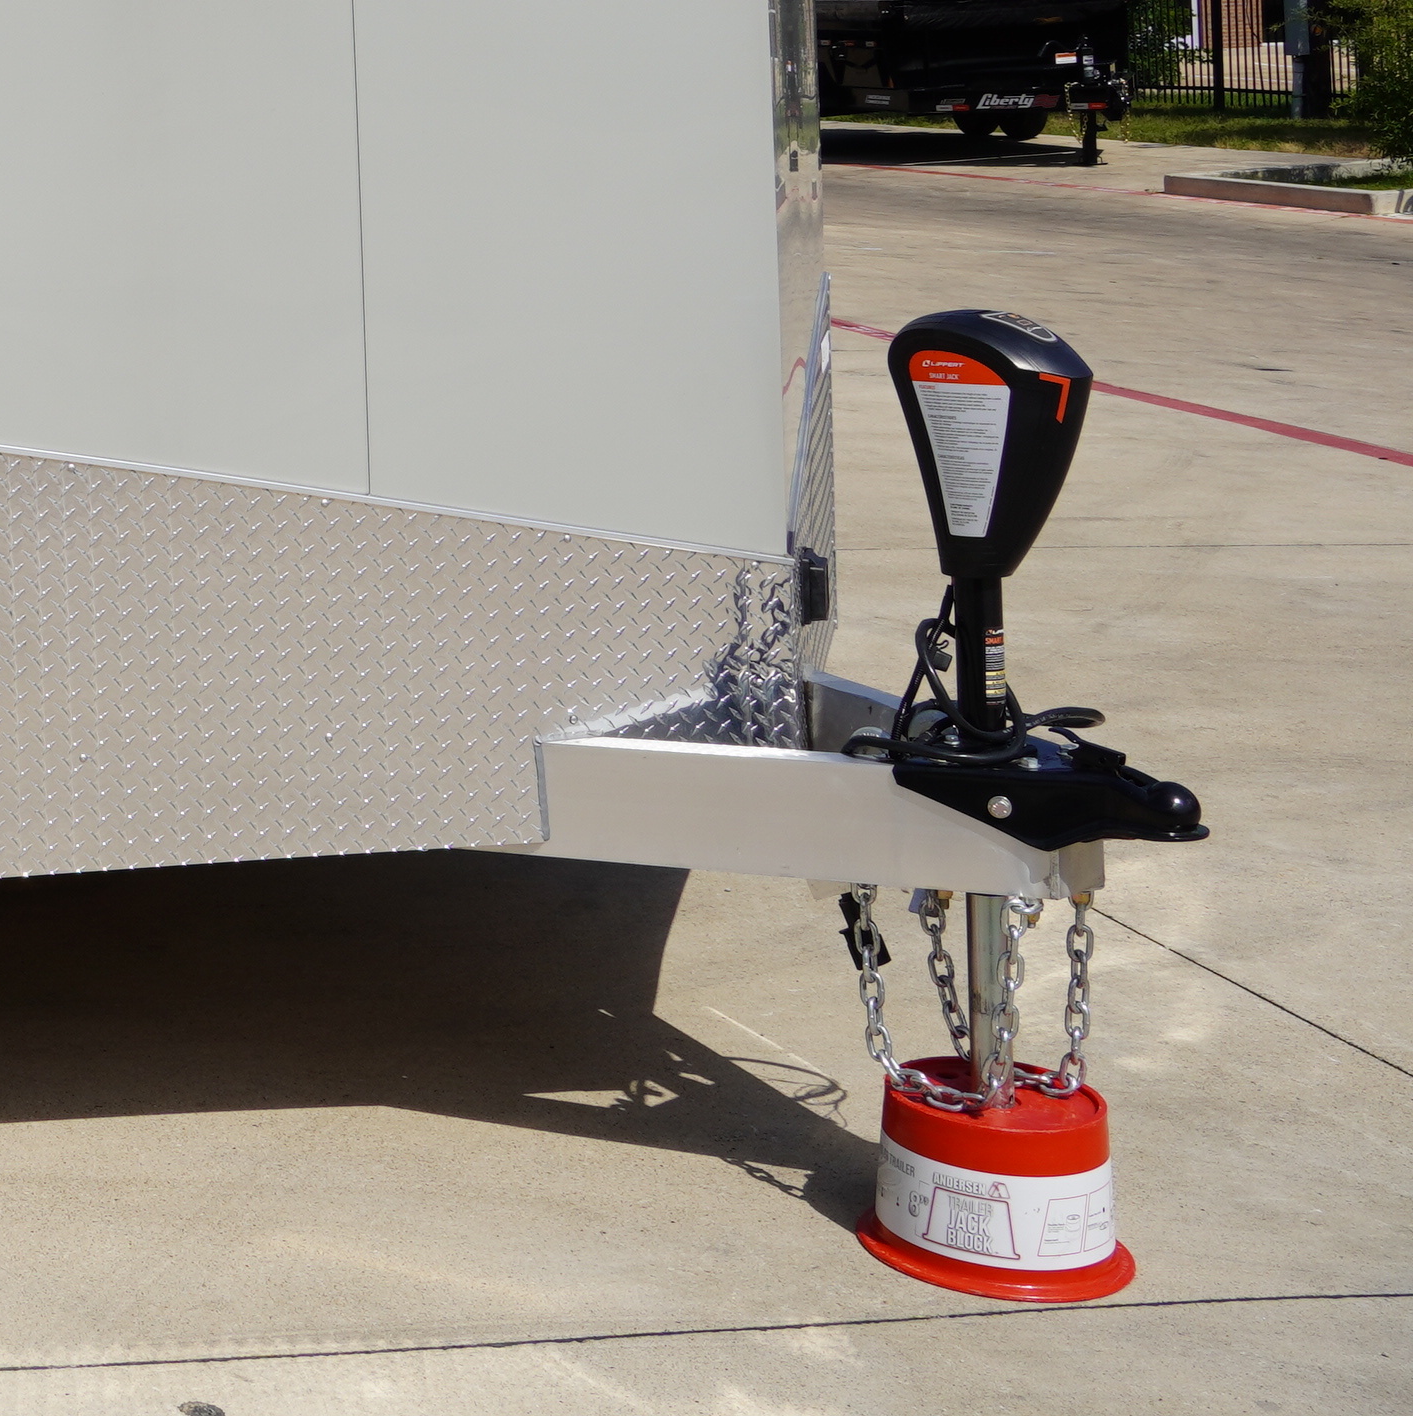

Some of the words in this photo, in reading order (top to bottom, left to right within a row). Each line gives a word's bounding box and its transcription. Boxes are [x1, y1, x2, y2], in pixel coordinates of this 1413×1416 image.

[975, 93, 1035, 110] Liberty
[933, 1171, 986, 1197] ANDERSEN
[947, 1193, 993, 1217] TRAILER
[947, 1208, 991, 1240] JACK
[947, 1227, 993, 1256] BLOCK
